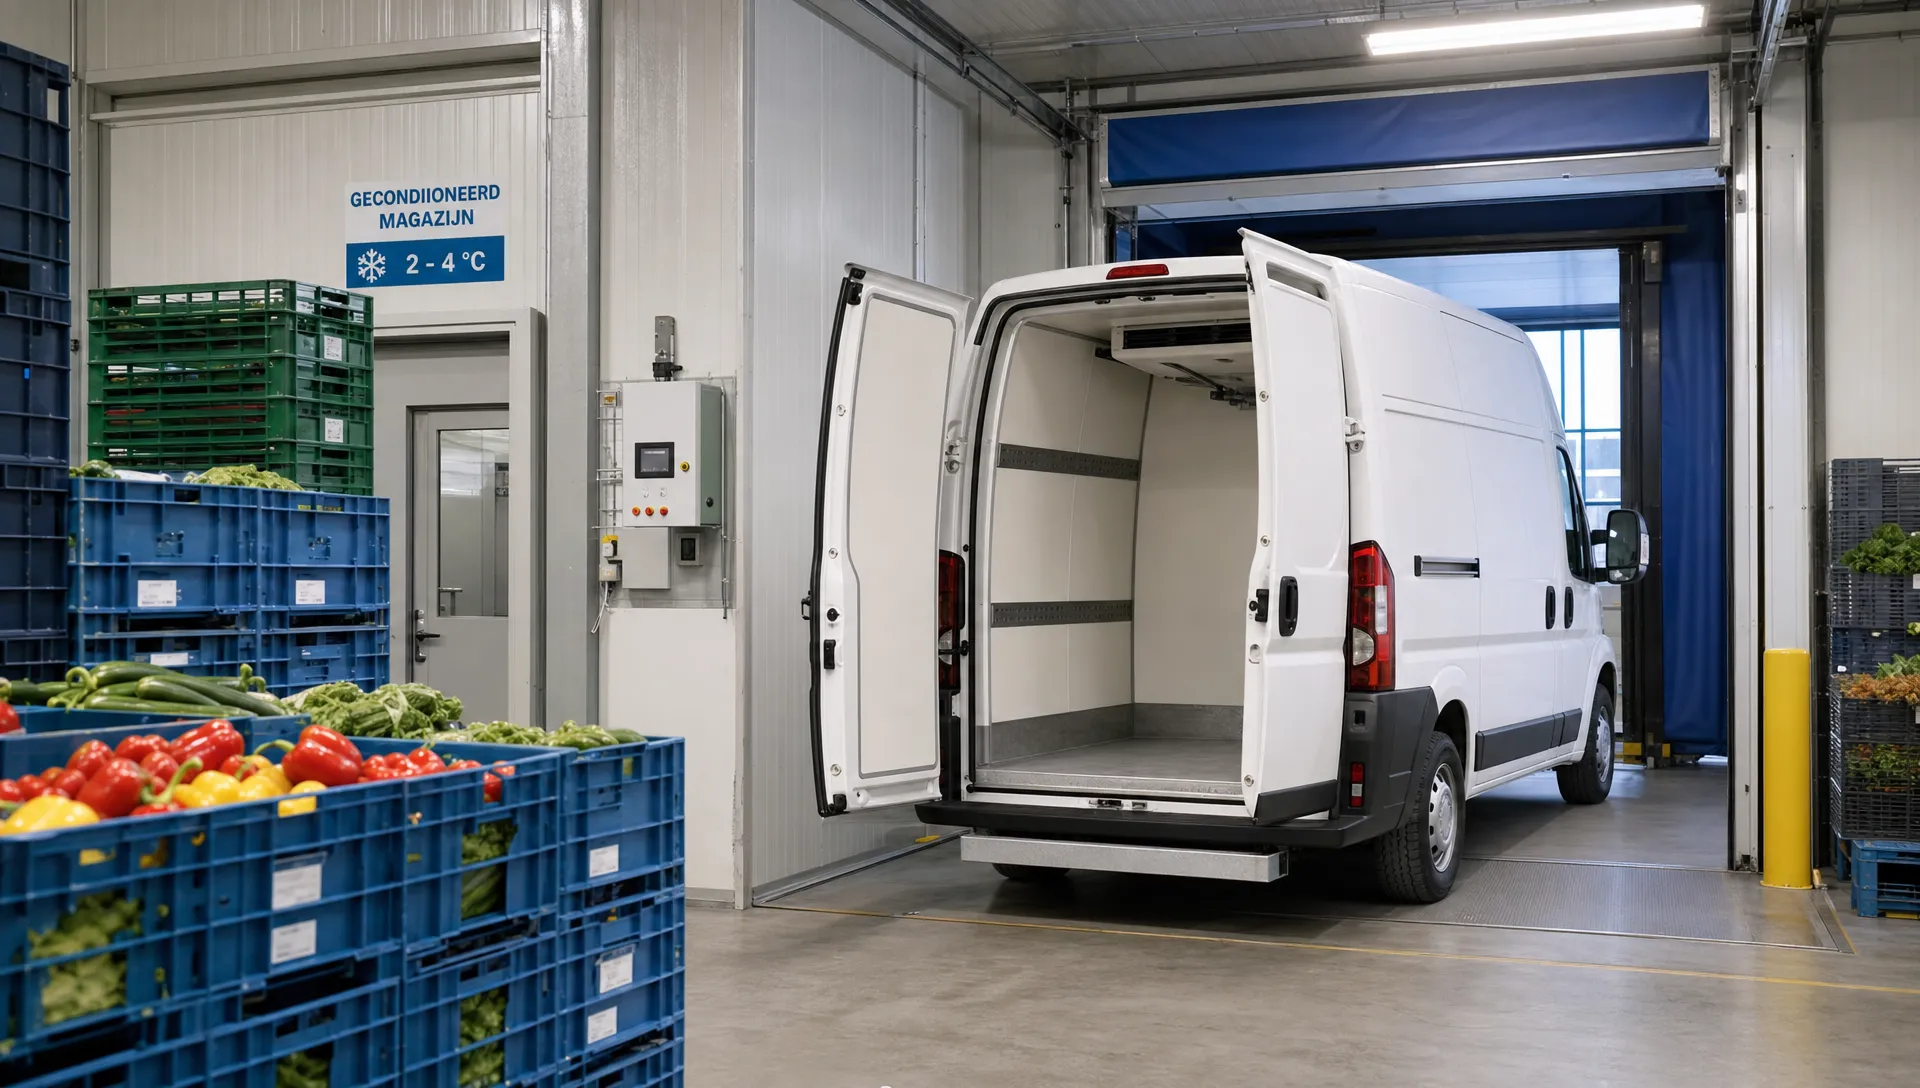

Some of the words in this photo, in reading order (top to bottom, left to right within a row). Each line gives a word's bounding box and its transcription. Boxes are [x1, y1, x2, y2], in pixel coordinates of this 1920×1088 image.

[350, 184, 501, 208] GECONDIIONEERD
[379, 208, 474, 230] MAGAZIJN
[406, 253, 419, 275] 2
[441, 252, 456, 273] 4
[462, 250, 486, 272] °C
